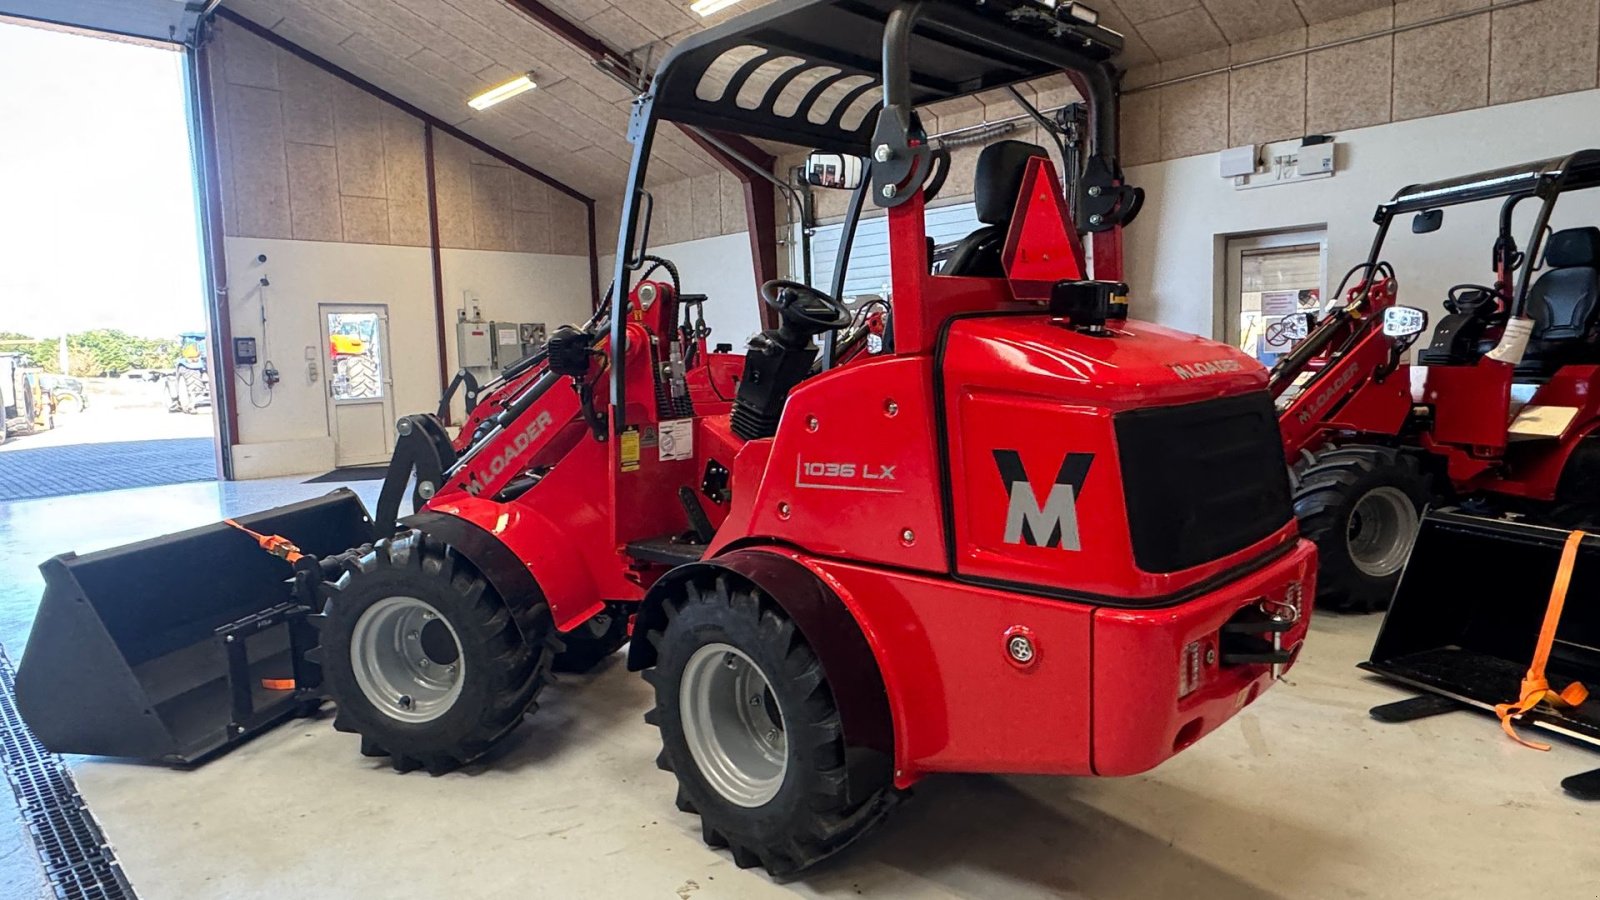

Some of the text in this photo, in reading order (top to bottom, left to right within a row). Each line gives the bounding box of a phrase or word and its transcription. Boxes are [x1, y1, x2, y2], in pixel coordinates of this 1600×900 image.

[480, 411, 552, 483] LOADER
[804, 462, 896, 480] 1036 LX
